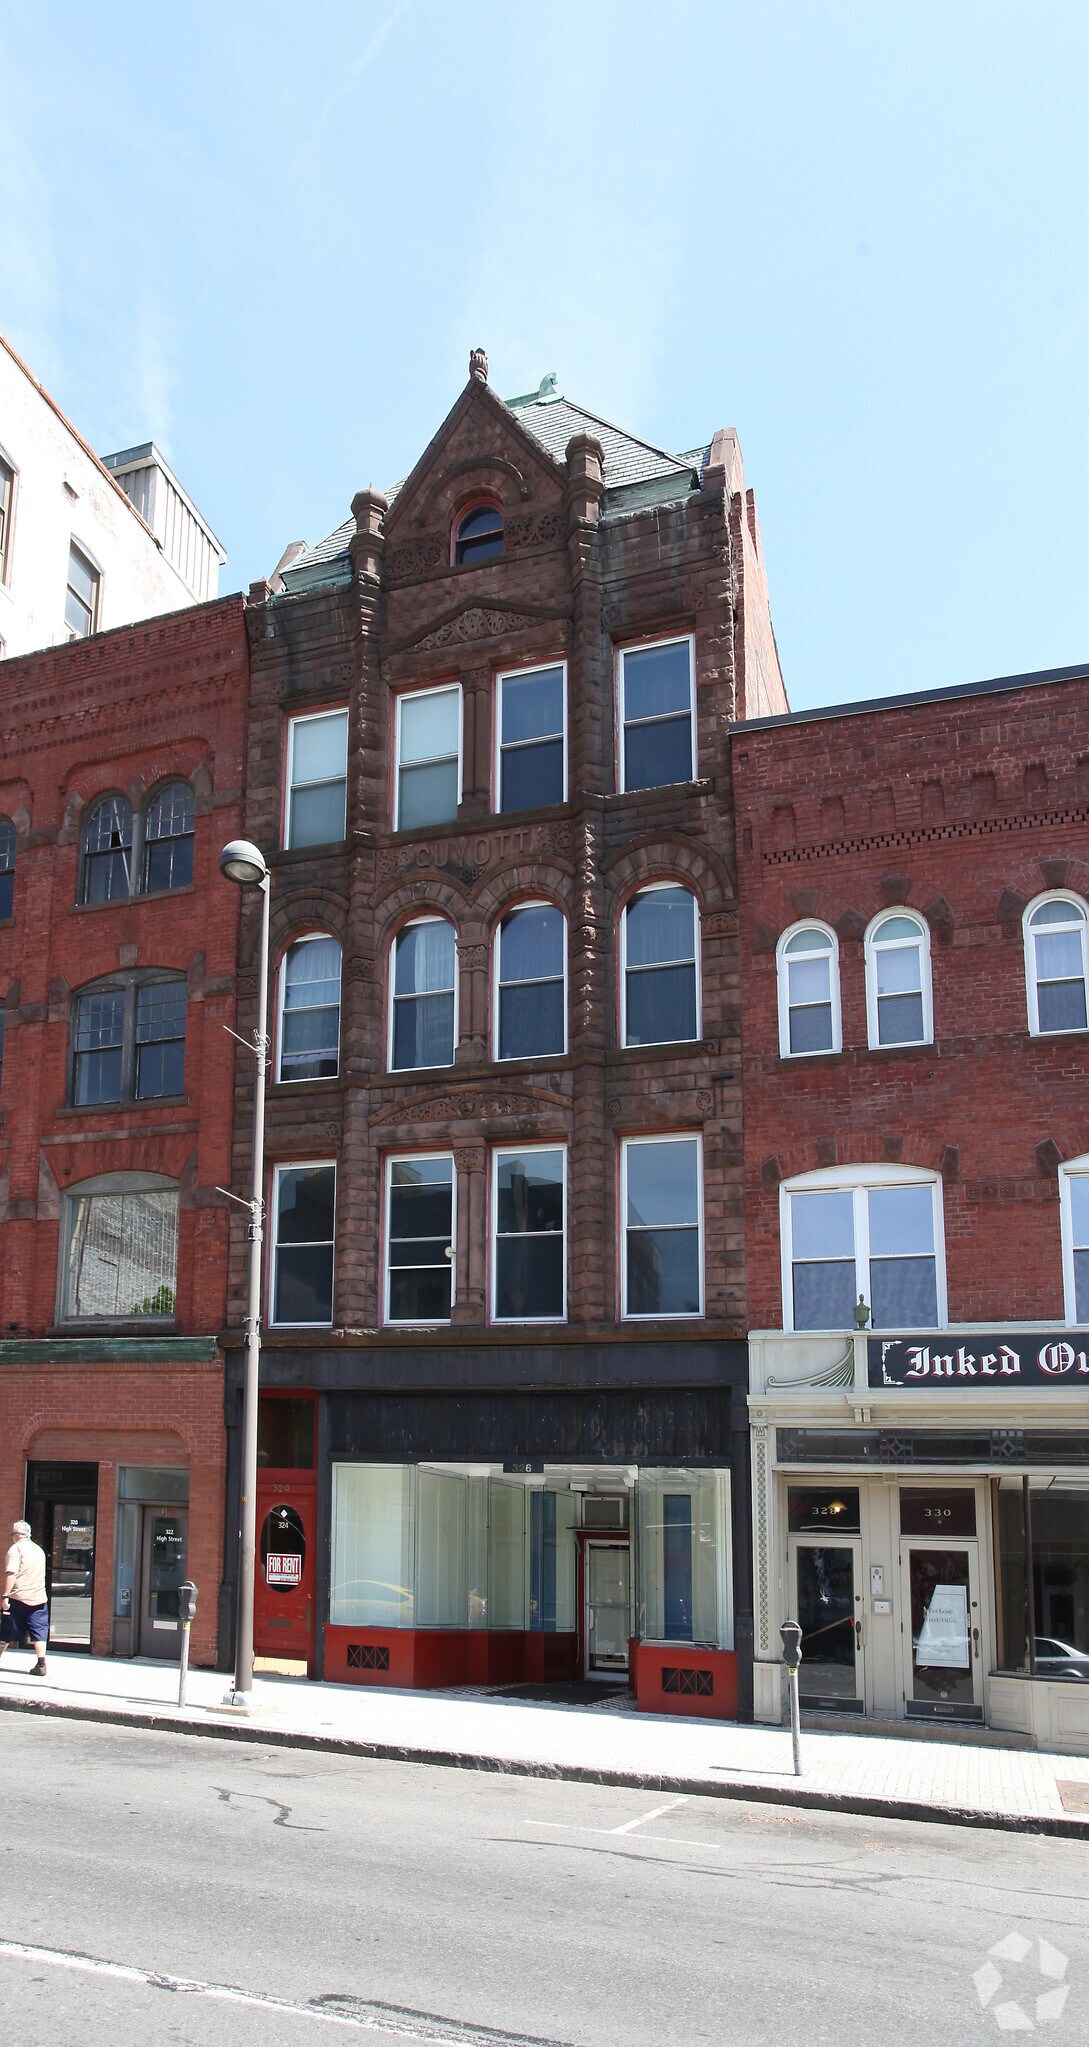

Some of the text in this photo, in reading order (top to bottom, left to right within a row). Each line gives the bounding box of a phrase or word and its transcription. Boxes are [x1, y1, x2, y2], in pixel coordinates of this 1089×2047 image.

[415, 831, 530, 868] GUYOTT
[459, 866, 485, 881] 1892
[904, 1345, 1022, 1378] Inked
[512, 1463, 532, 1473] 326
[272, 1484, 290, 1493] 324
[812, 1506, 837, 1515] 328
[924, 1508, 951, 1517] 330
[61, 1525, 72, 1533] High
[278, 1521, 289, 1529] 324
[269, 1557, 299, 1573] FOR RENT
